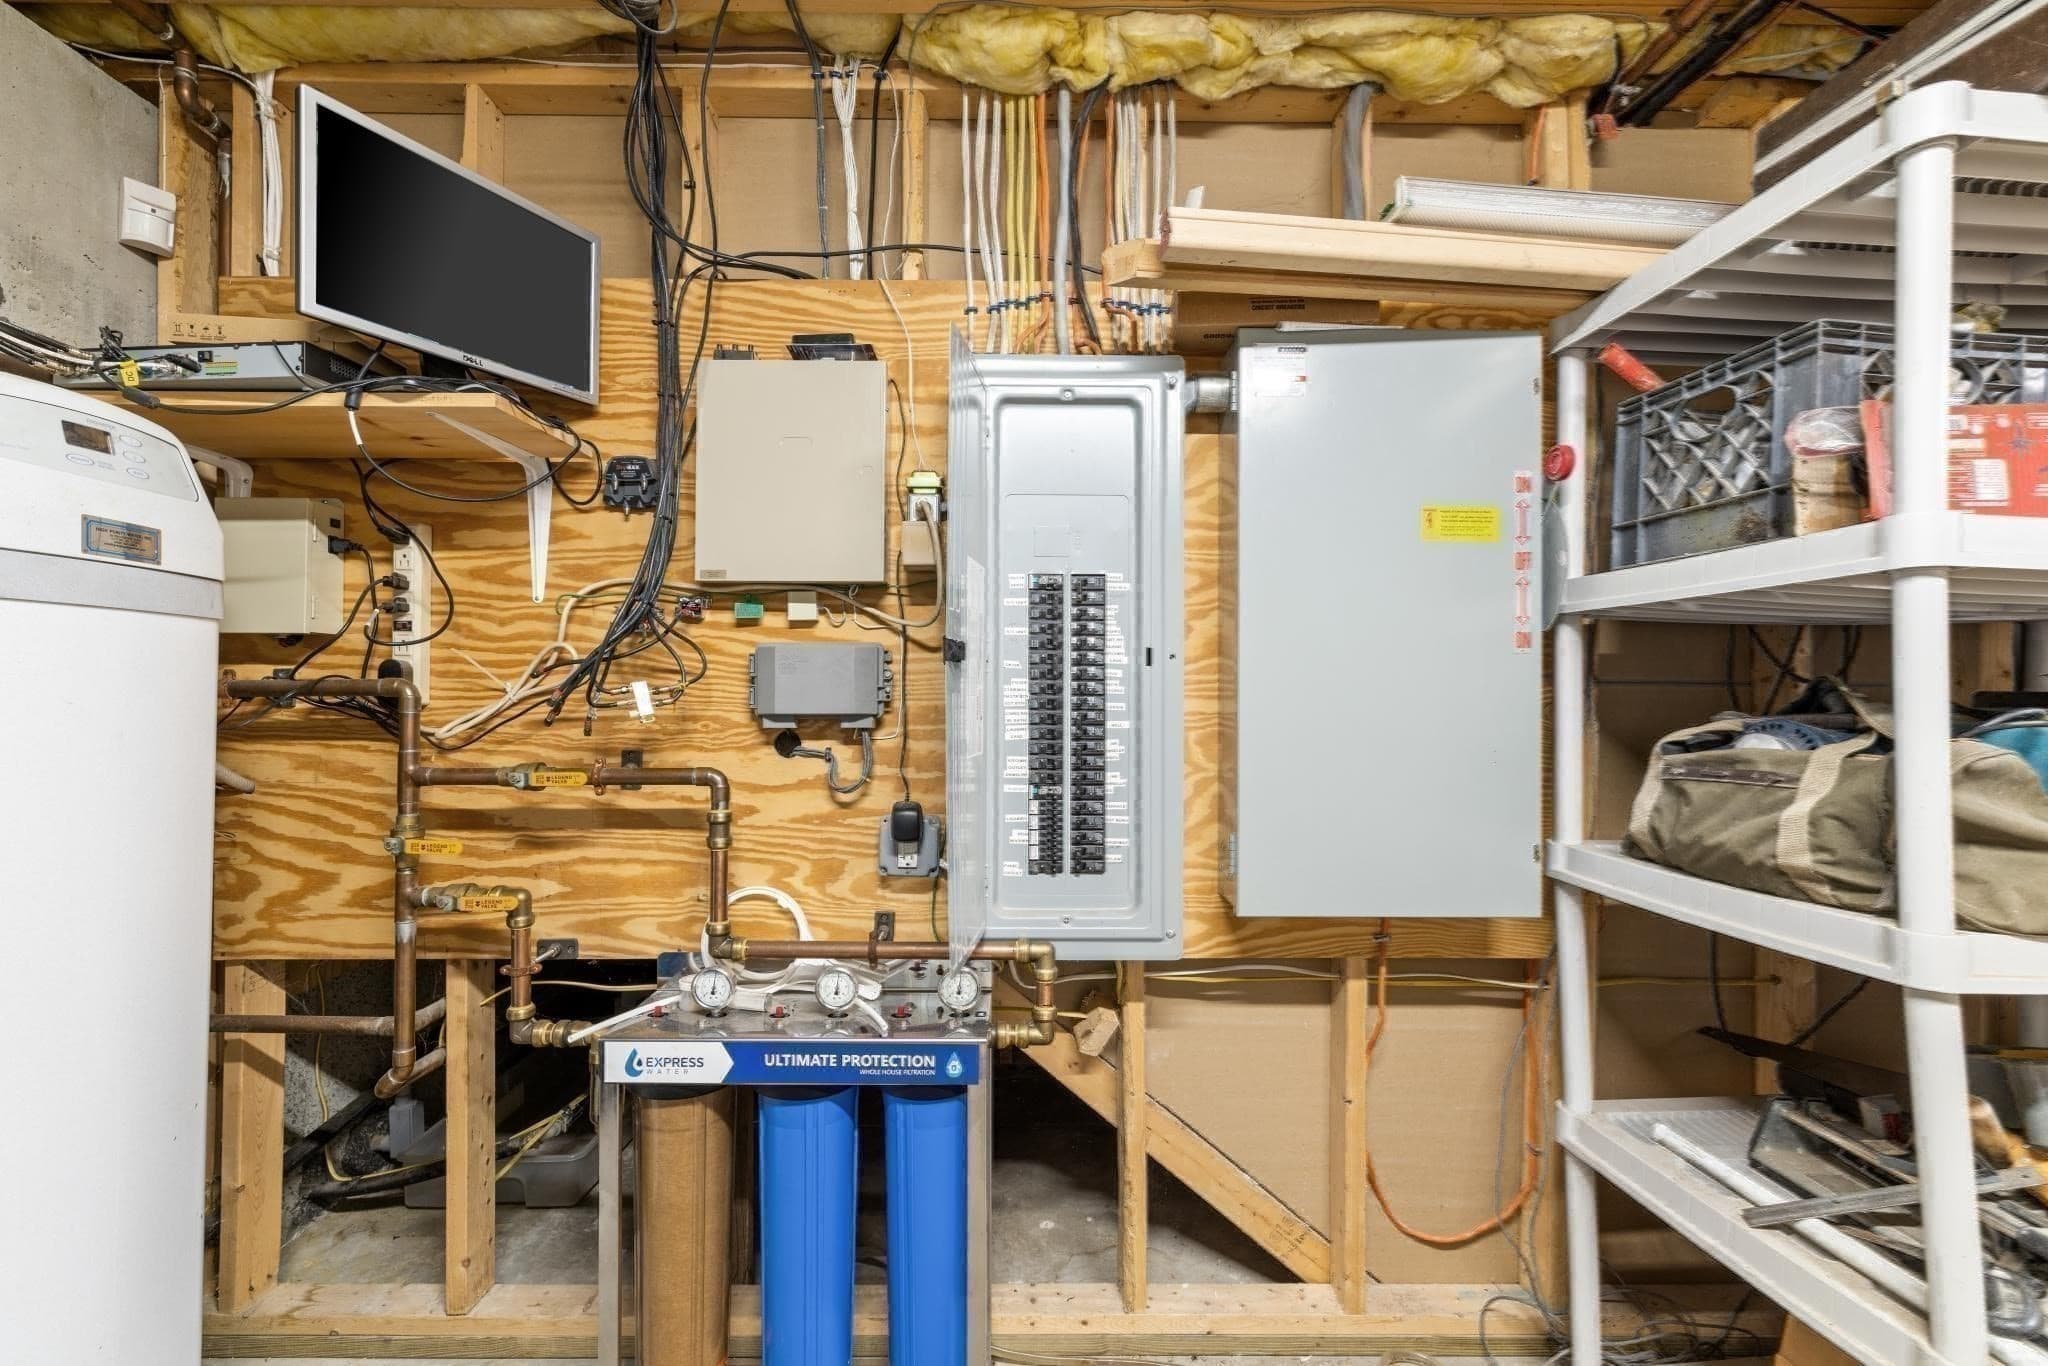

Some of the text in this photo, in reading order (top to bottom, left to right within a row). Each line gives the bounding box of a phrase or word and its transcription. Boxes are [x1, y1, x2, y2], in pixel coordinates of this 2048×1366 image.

[463, 354, 484, 367] DELL
[126, 371, 135, 382] DC
[646, 1057, 704, 1067] EXPRESS
[764, 1053, 936, 1068] ULTIMATE PROTECTION
